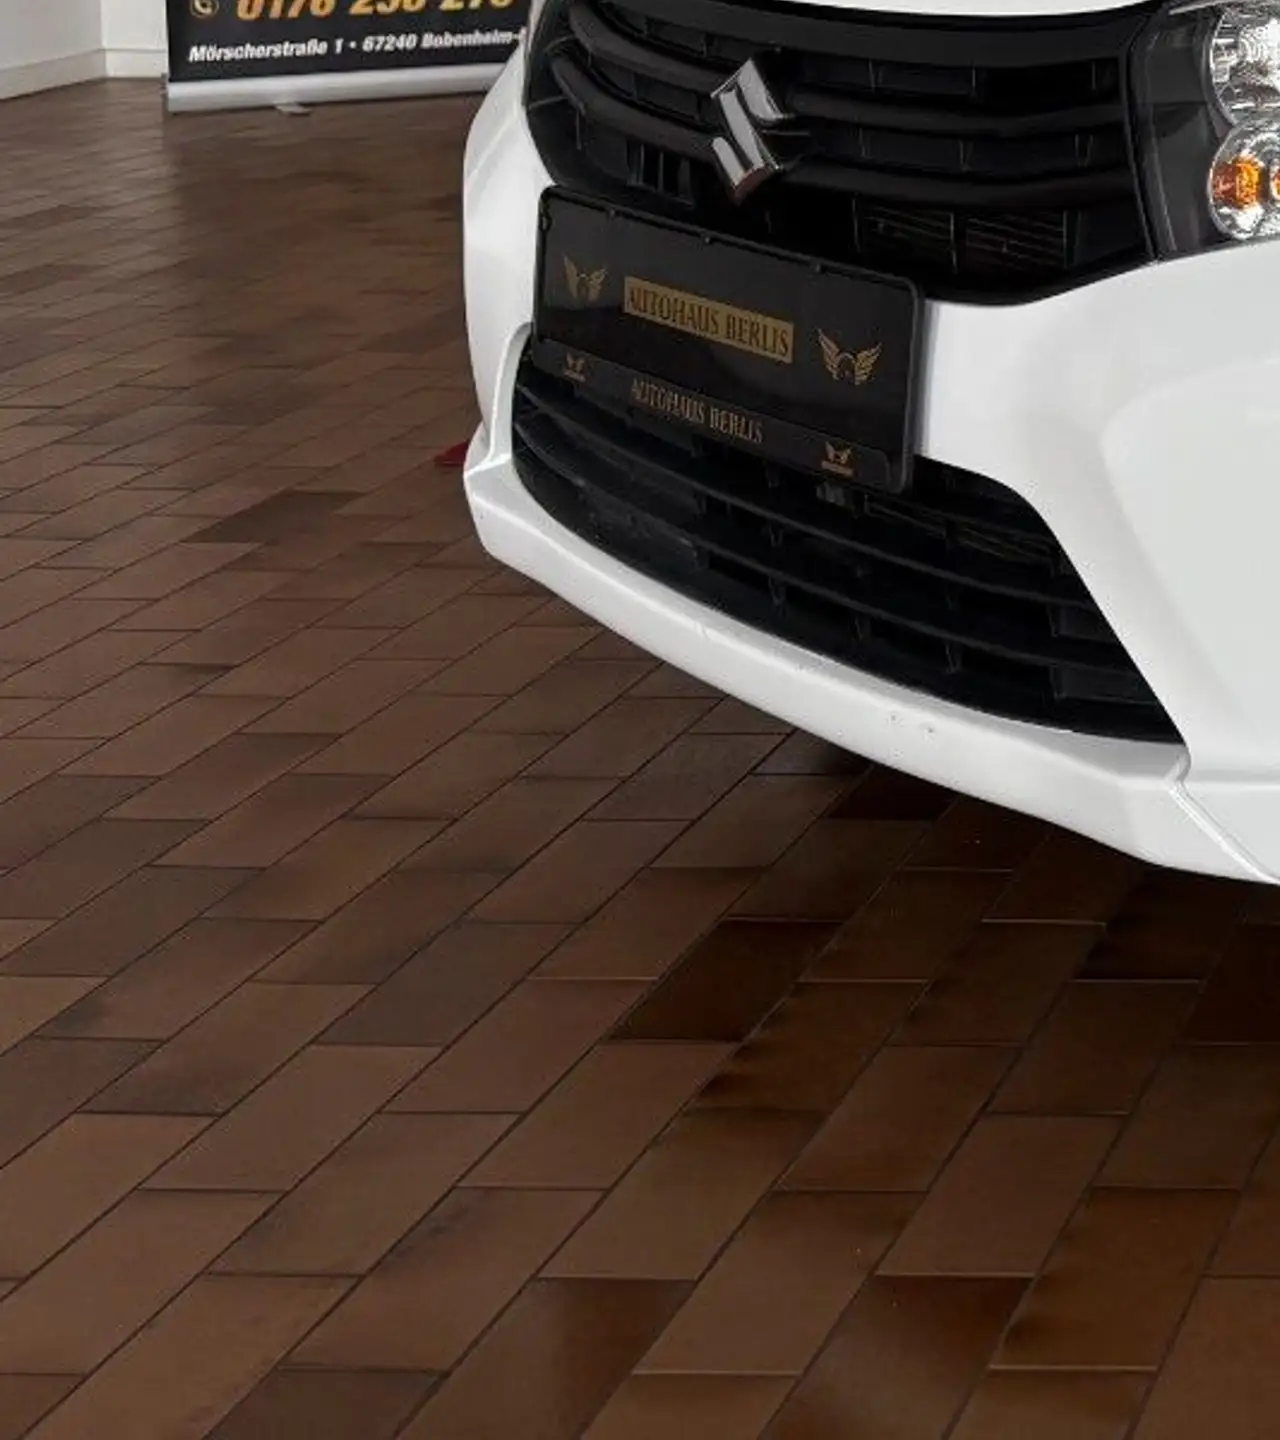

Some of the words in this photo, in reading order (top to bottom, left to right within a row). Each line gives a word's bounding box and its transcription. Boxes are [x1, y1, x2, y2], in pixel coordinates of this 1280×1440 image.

[188, 38, 328, 62] Mörscherstraße
[334, 38, 343, 53] 1
[362, 33, 417, 52] 67240
[628, 285, 719, 335] AUTOHAUS
[726, 314, 790, 357] BERLIS
[631, 379, 705, 424] AUTOHAUS
[709, 407, 764, 444] BERLIS
